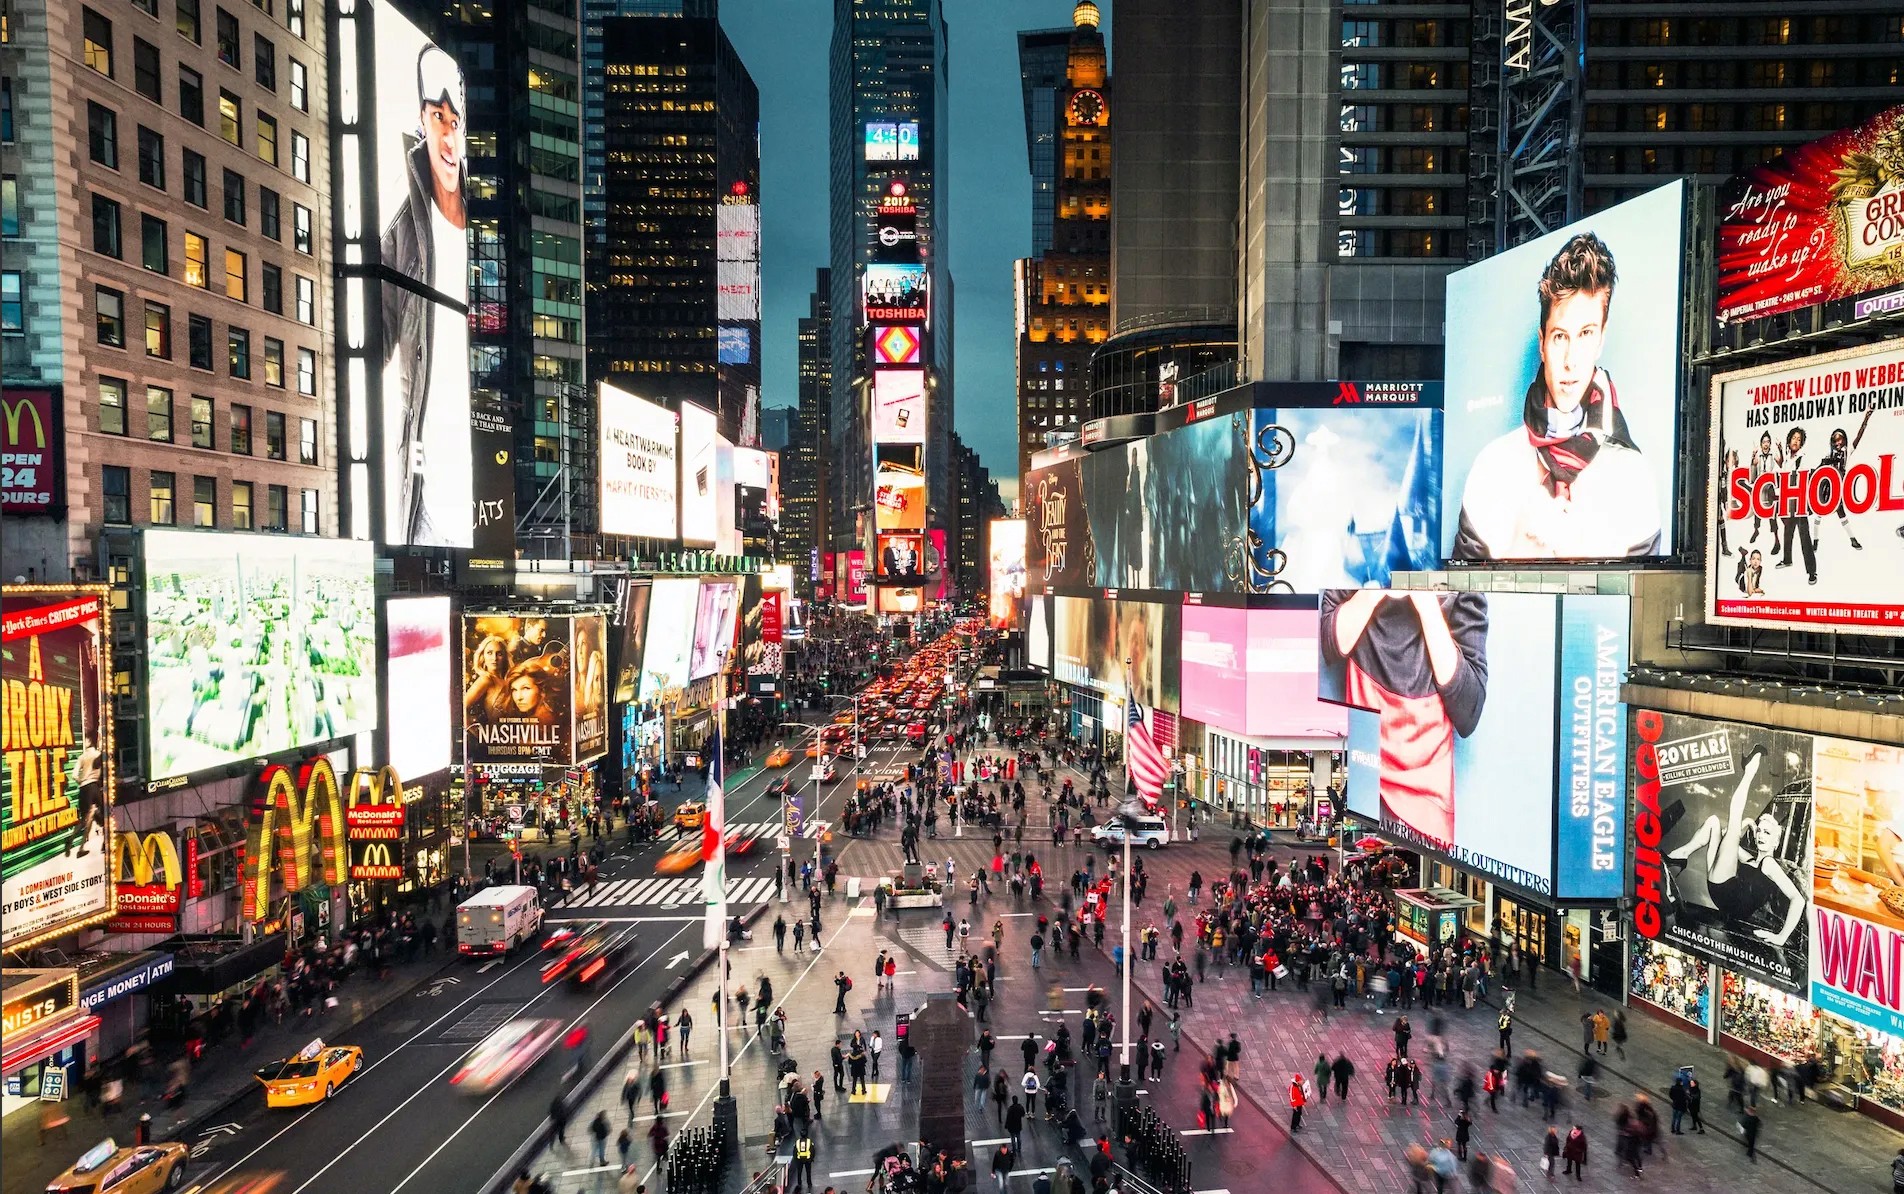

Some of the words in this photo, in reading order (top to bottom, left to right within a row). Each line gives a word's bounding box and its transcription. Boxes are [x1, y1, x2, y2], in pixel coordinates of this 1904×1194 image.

[873, 128, 911, 143] 4:50
[878, 206, 916, 214] TOSHIBA
[884, 197, 910, 206] 2017
[1724, 185, 1762, 221] Are
[1756, 183, 1790, 223] you
[1738, 201, 1786, 254] ready
[1782, 211, 1798, 232] to
[1748, 234, 1788, 276] wake
[1785, 228, 1825, 282] up?
[868, 309, 926, 319] TOSHIBA
[1730, 302, 1754, 317] IMPERIAL
[1755, 298, 1778, 312] THEATRE
[1366, 384, 1424, 392] MARRIOTT
[1366, 393, 1418, 401] MARQUIS
[1809, 371, 1851, 396] LLOYD
[476, 412, 492, 422] BACK
[492, 415, 504, 423] AND
[479, 420, 496, 430] THAN
[1747, 408, 1769, 428] HAS
[1773, 395, 1845, 424] BROADWAY
[613, 428, 673, 460] HEARTWARMING
[627, 452, 647, 472] BOOK
[2, 468, 36, 487] 24
[1729, 454, 1904, 521] SCHOOL
[81, 601, 98, 615] PICK
[1806, 607, 1828, 616] WINTER
[1853, 609, 1879, 619] THEATRE
[29, 634, 43, 681] A
[1593, 624, 1619, 775] AMERICAN
[478, 725, 560, 744] NASHVILLE
[1572, 676, 1593, 818] OUTFITTERS
[488, 746, 516, 755] THURSDAYS
[517, 746, 531, 755] 9PM
[1658, 747, 1681, 766] 20
[1680, 735, 1728, 762] YEARS
[6, 748, 68, 822] TALE
[1592, 780, 1617, 871] EAGLE
[1635, 710, 1664, 939] CHICAGO
[1379, 818, 1433, 850] AMERICAN
[1434, 835, 1469, 864] EAGLE
[1471, 851, 1550, 895] OUTFITTERS
[14, 896, 35, 911] BOYS
[43, 887, 63, 901] WEST
[64, 882, 80, 895] SIDE
[25, 876, 66, 895] COMBINATION
[66, 872, 74, 881] OF
[117, 893, 176, 904] cDonald's
[1672, 925, 1791, 977] CHICAGOTHEMUSICAL.COM
[108, 972, 146, 998] MONEY
[151, 961, 173, 979] ATM
[3, 999, 56, 1032] NISTS
